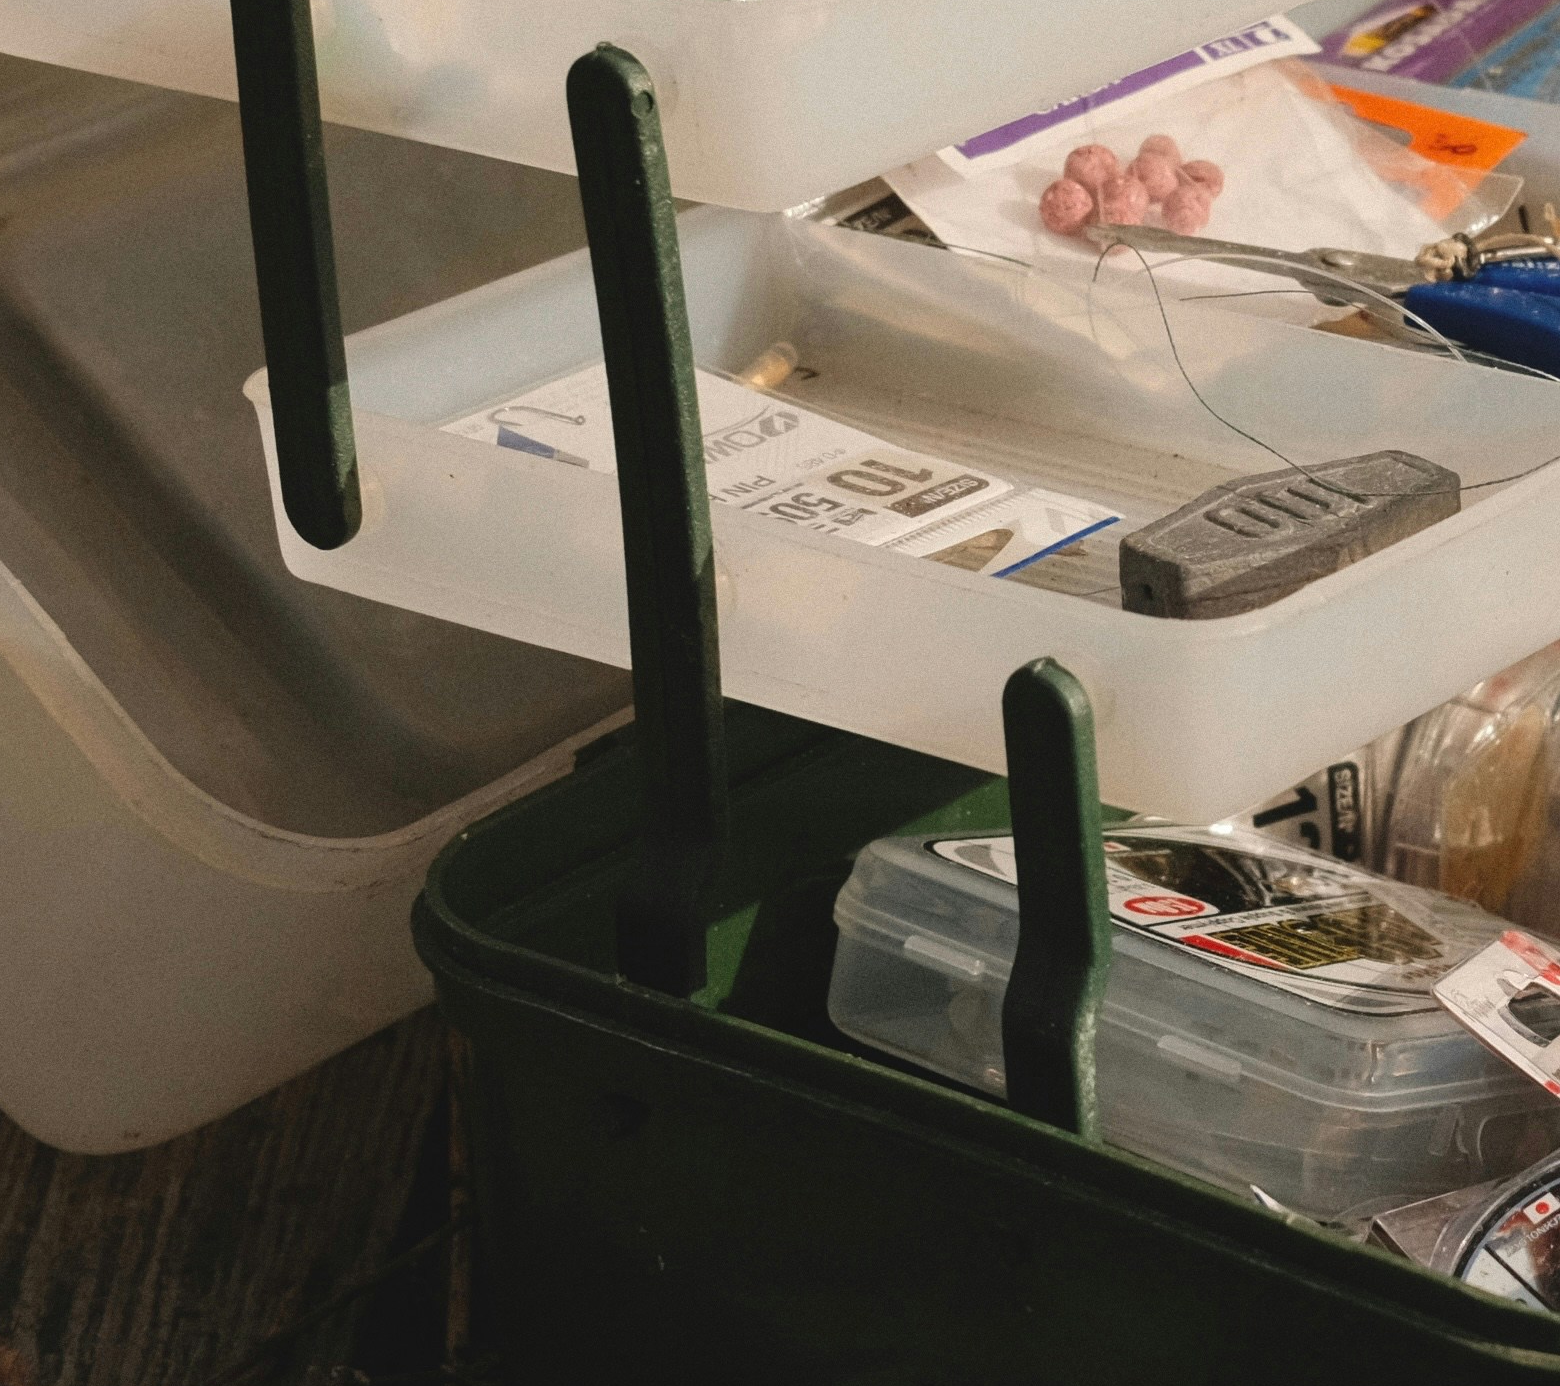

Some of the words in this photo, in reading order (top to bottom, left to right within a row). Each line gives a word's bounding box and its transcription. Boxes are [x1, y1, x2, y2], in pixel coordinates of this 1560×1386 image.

[732, 474, 776, 501] PIN
[827, 459, 933, 496] 10
[761, 491, 844, 524] 50
